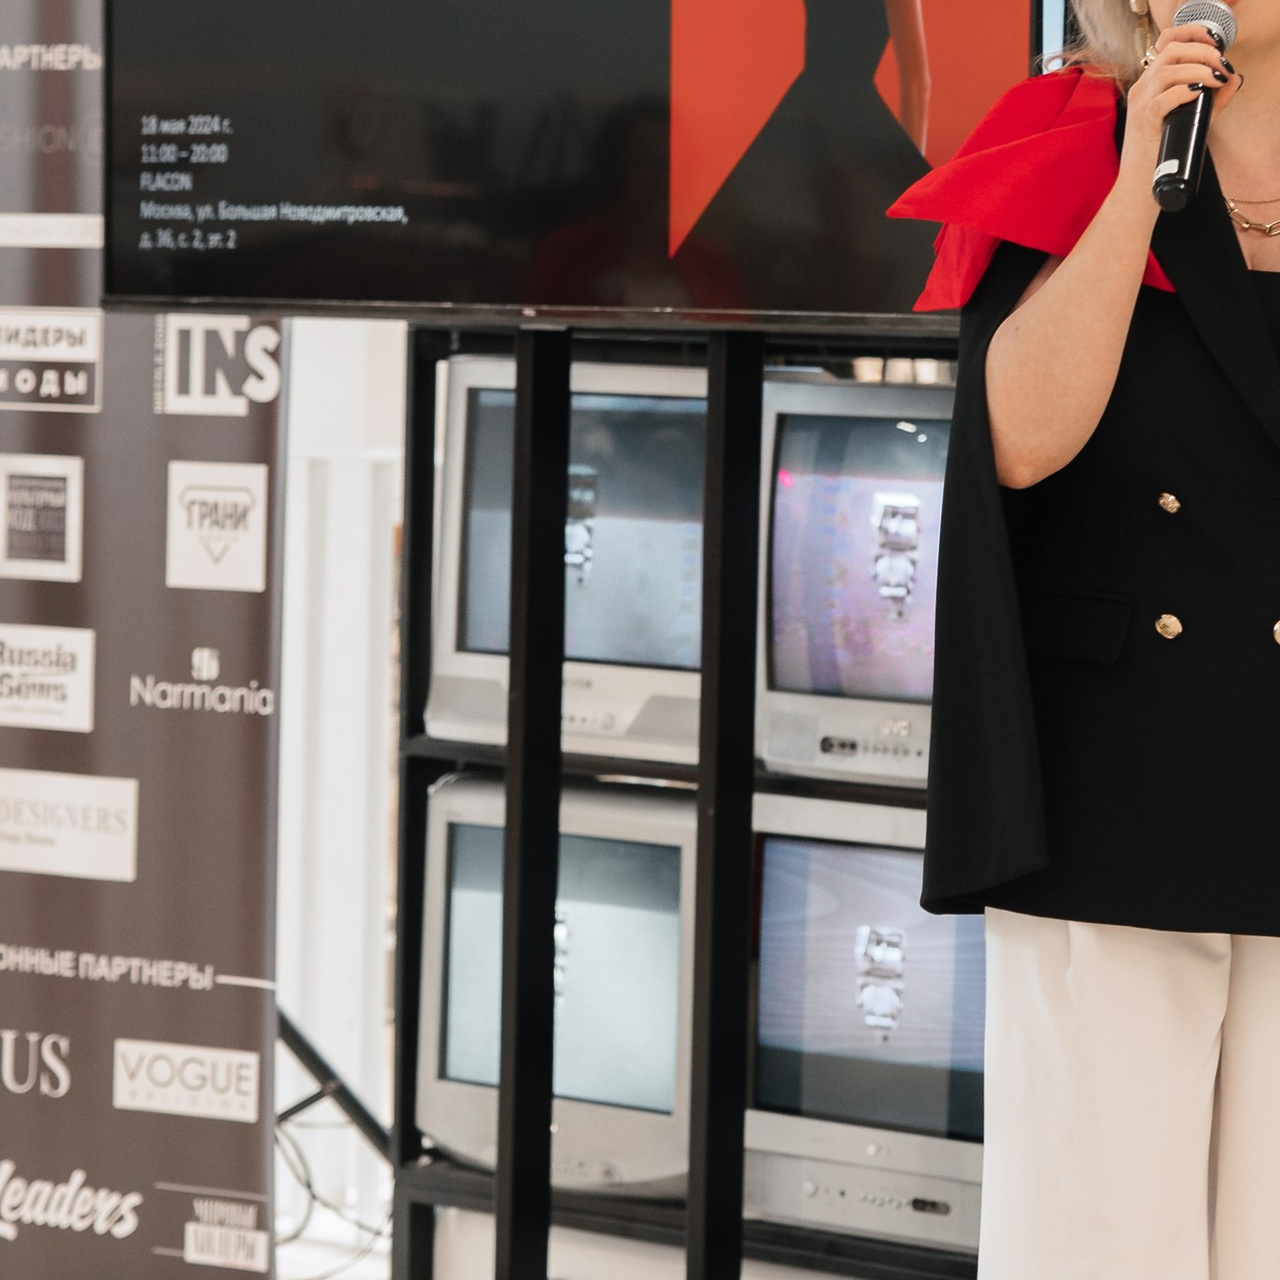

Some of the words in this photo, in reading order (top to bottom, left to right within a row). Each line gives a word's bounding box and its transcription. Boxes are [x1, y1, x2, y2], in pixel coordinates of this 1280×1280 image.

[188, 114, 221, 135] 2024
[0, 324, 87, 349] ИДЕРЫ
[185, 499, 250, 532] ГРАНИ
[130, 674, 275, 716] Narmania
[78, 952, 215, 991] ПАРТНЕРЫ
[119, 1052, 252, 1098] VOGUE
